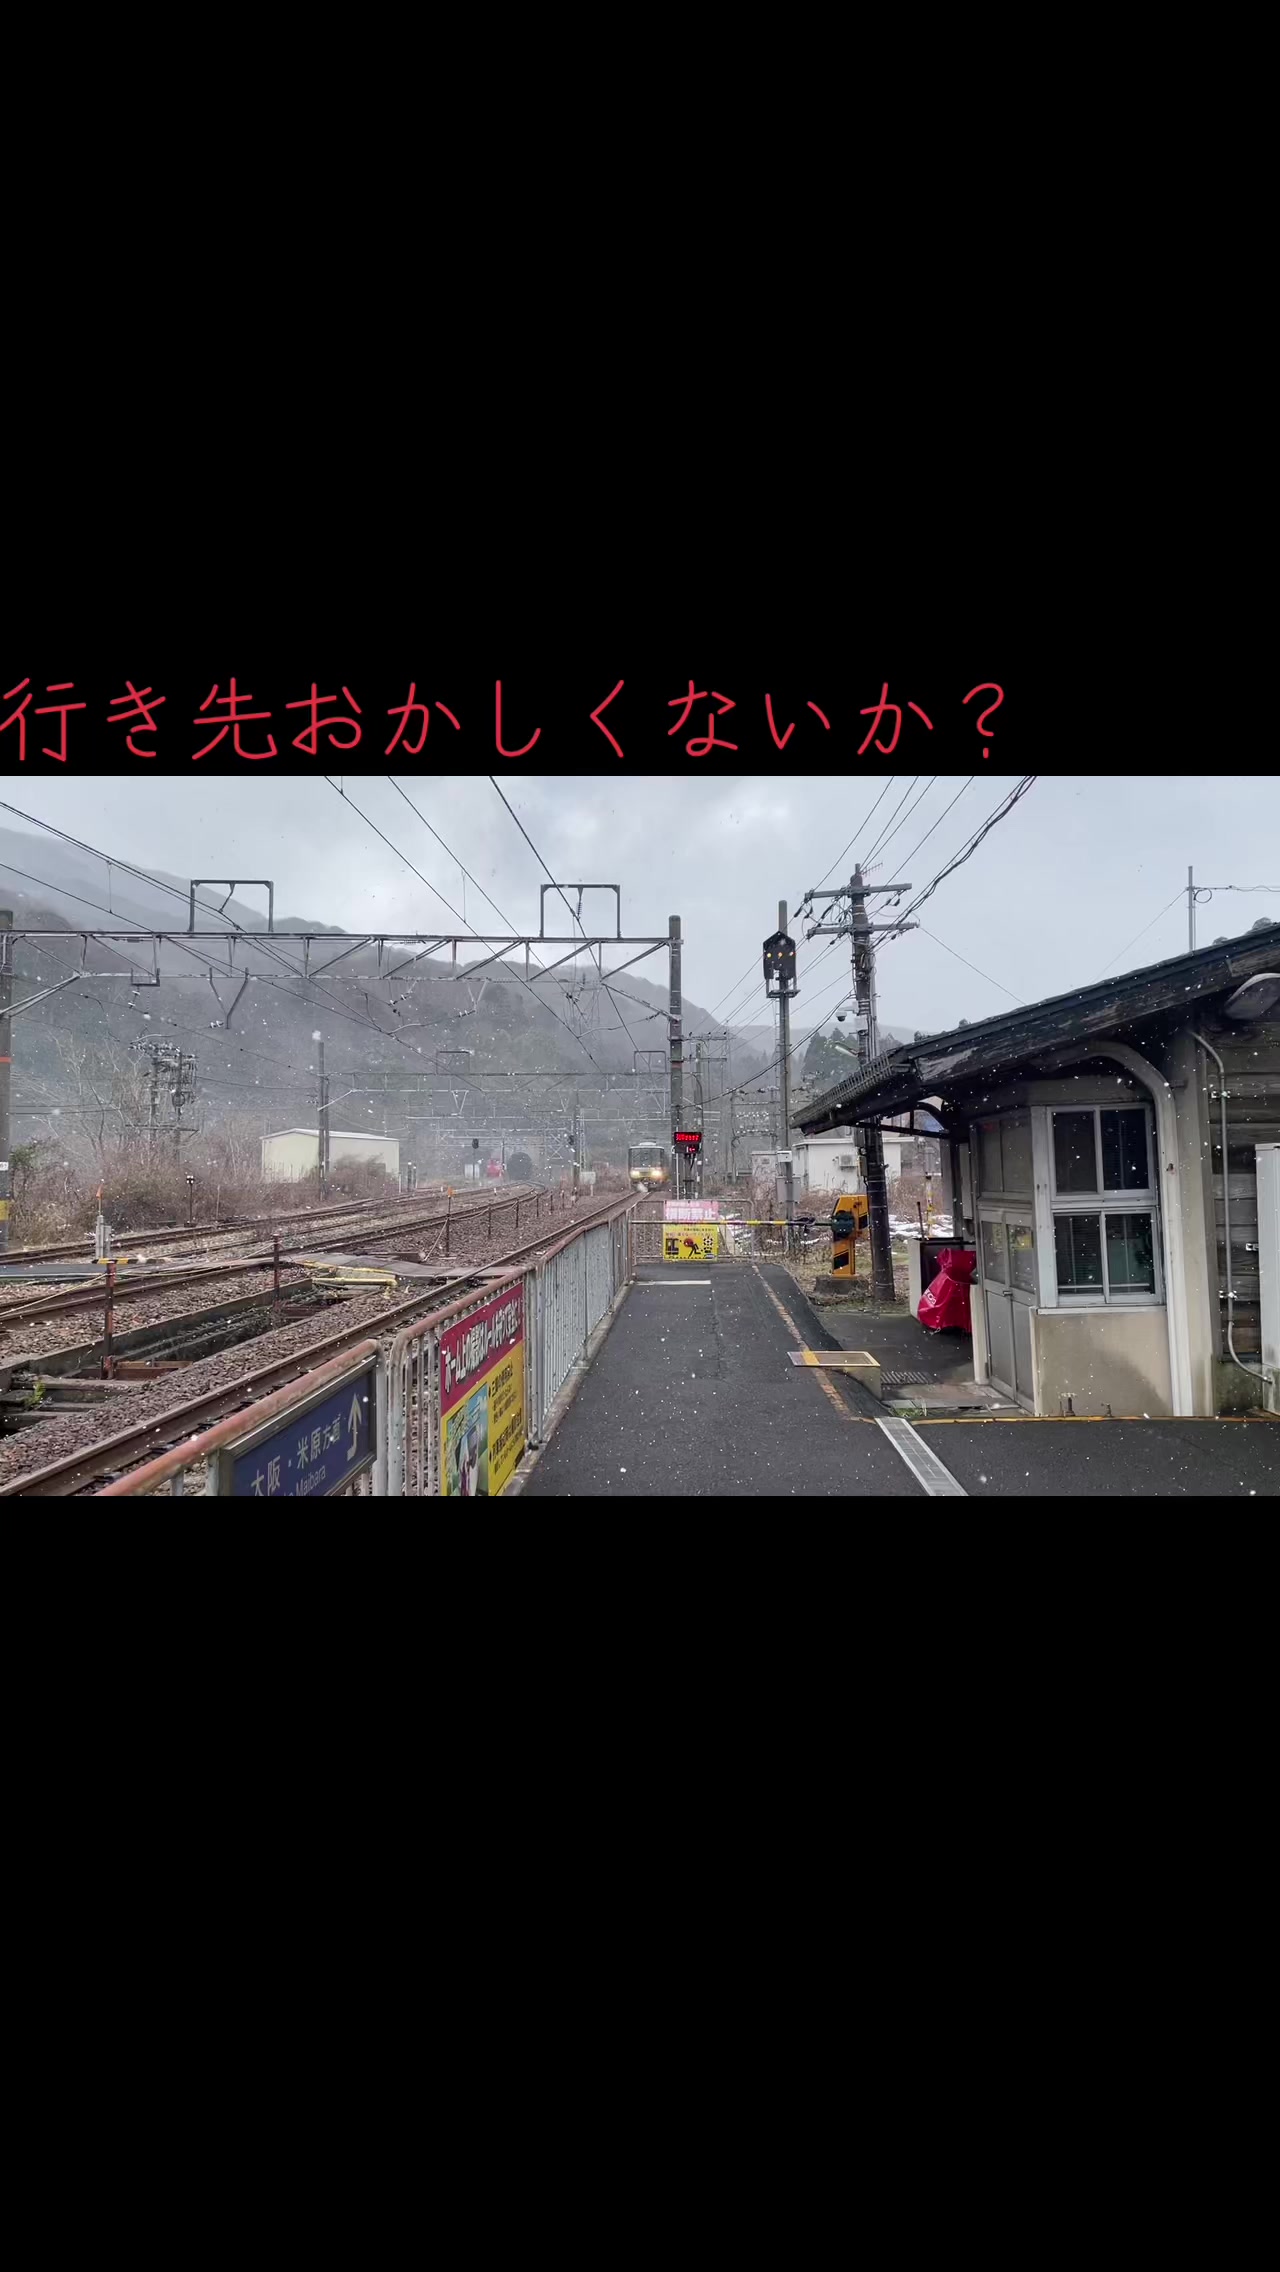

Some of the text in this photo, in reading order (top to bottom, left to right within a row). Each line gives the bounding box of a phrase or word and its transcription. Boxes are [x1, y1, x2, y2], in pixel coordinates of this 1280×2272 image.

[251, 1414, 342, 1496] 大阪・米原方面
